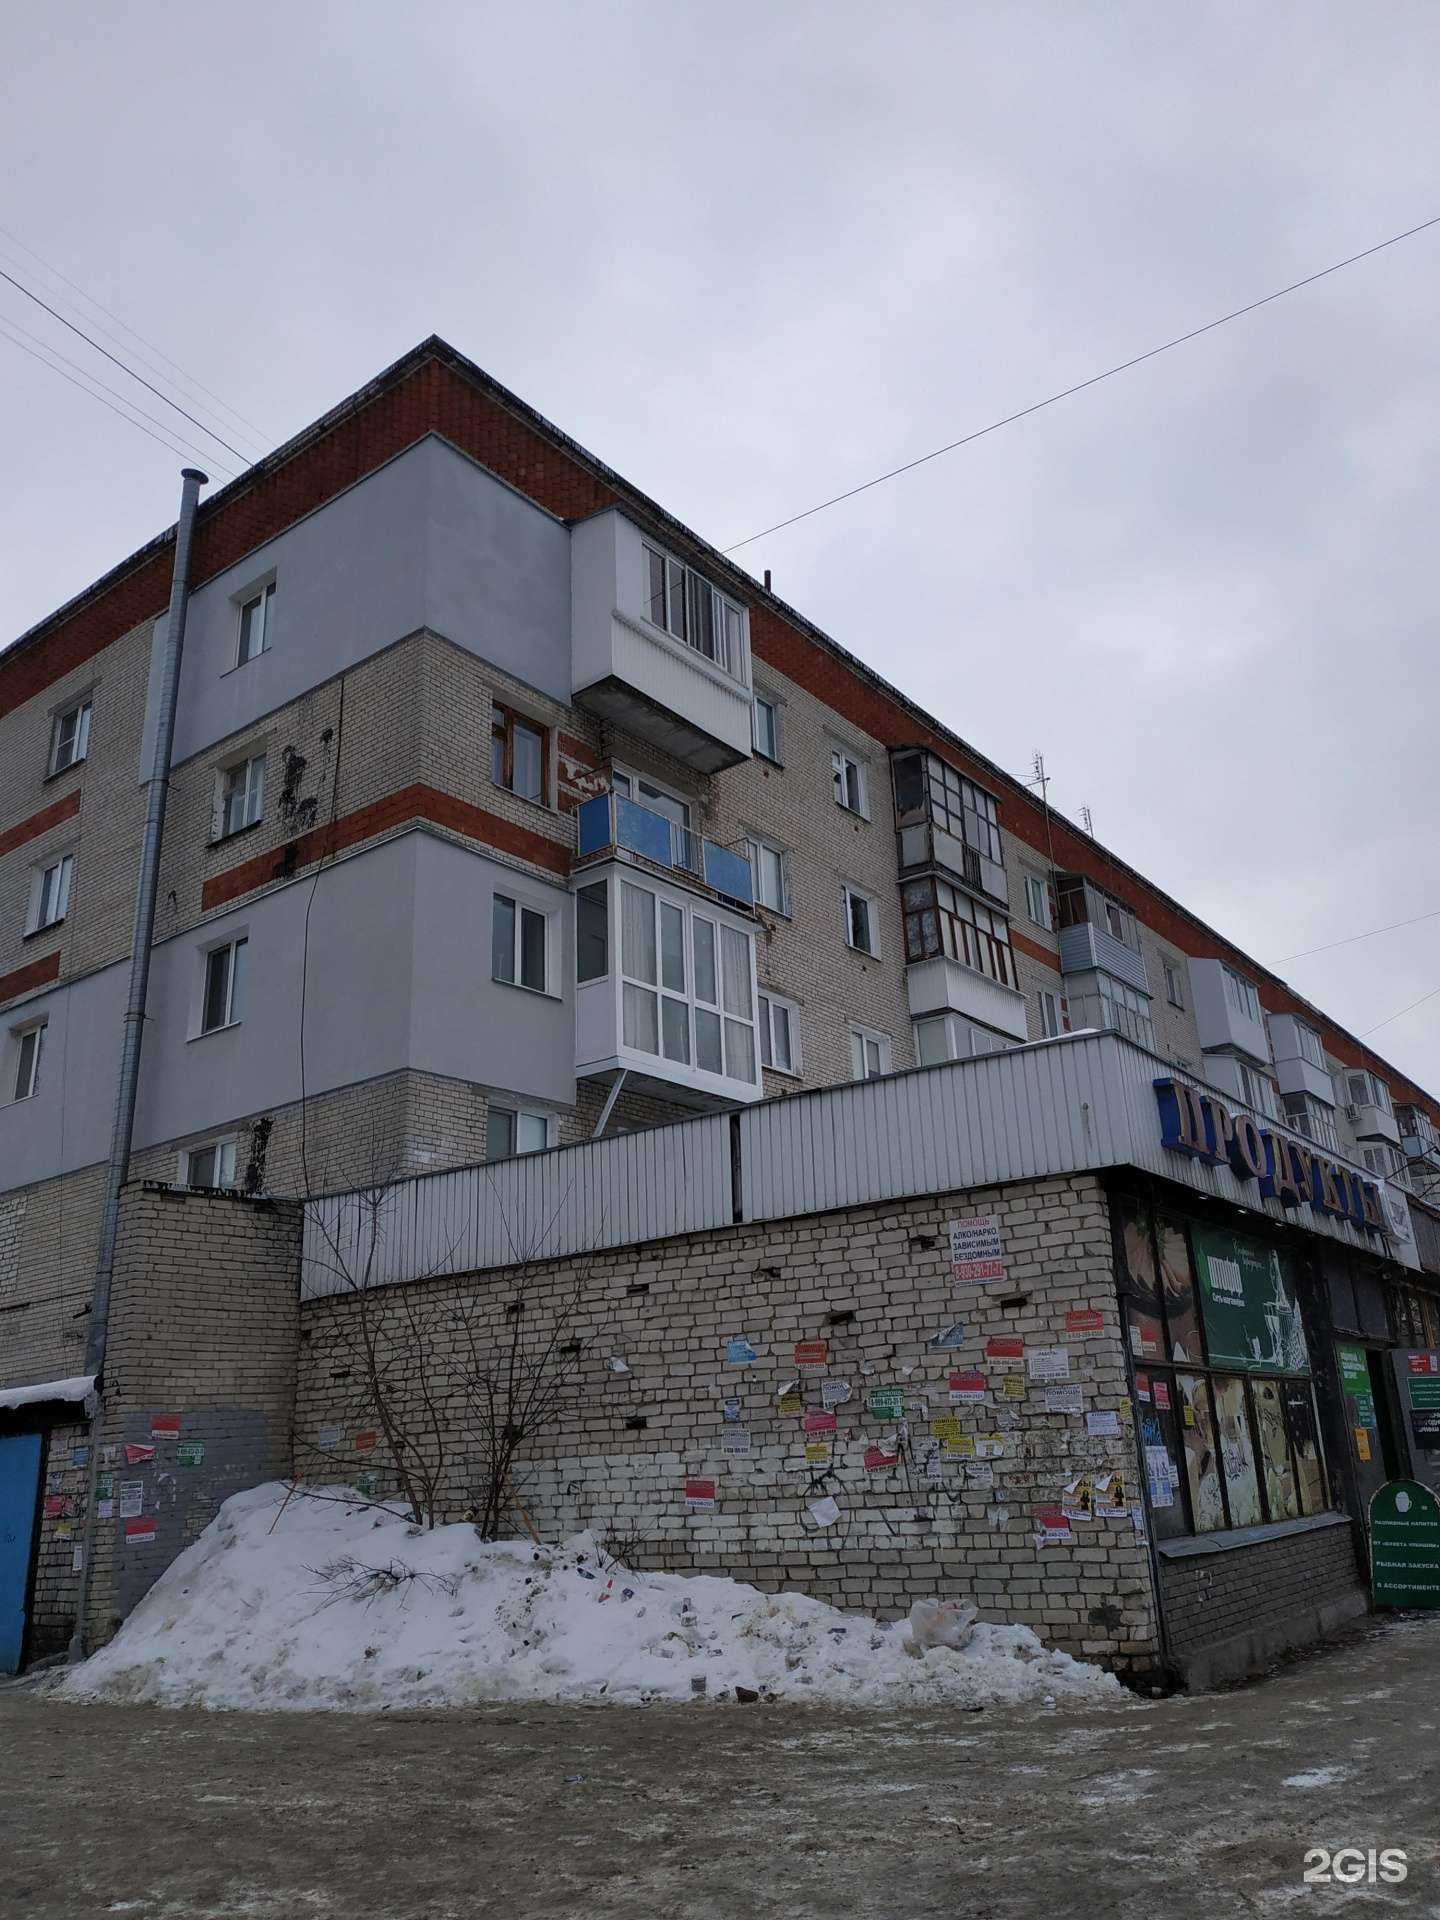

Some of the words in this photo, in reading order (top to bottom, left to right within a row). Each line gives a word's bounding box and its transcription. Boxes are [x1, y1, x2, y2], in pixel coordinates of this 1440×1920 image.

[1154, 1077, 1387, 1233] ПРОДУКТЫ
[957, 1217, 990, 1228] ПОМОЩЬ
[953, 1227, 997, 1239] АЛКО/НАРКО
[953, 1237, 999, 1250] ЗАВИСИМЫМ
[954, 1248, 1000, 1262] БЕЗДОМНЫМ
